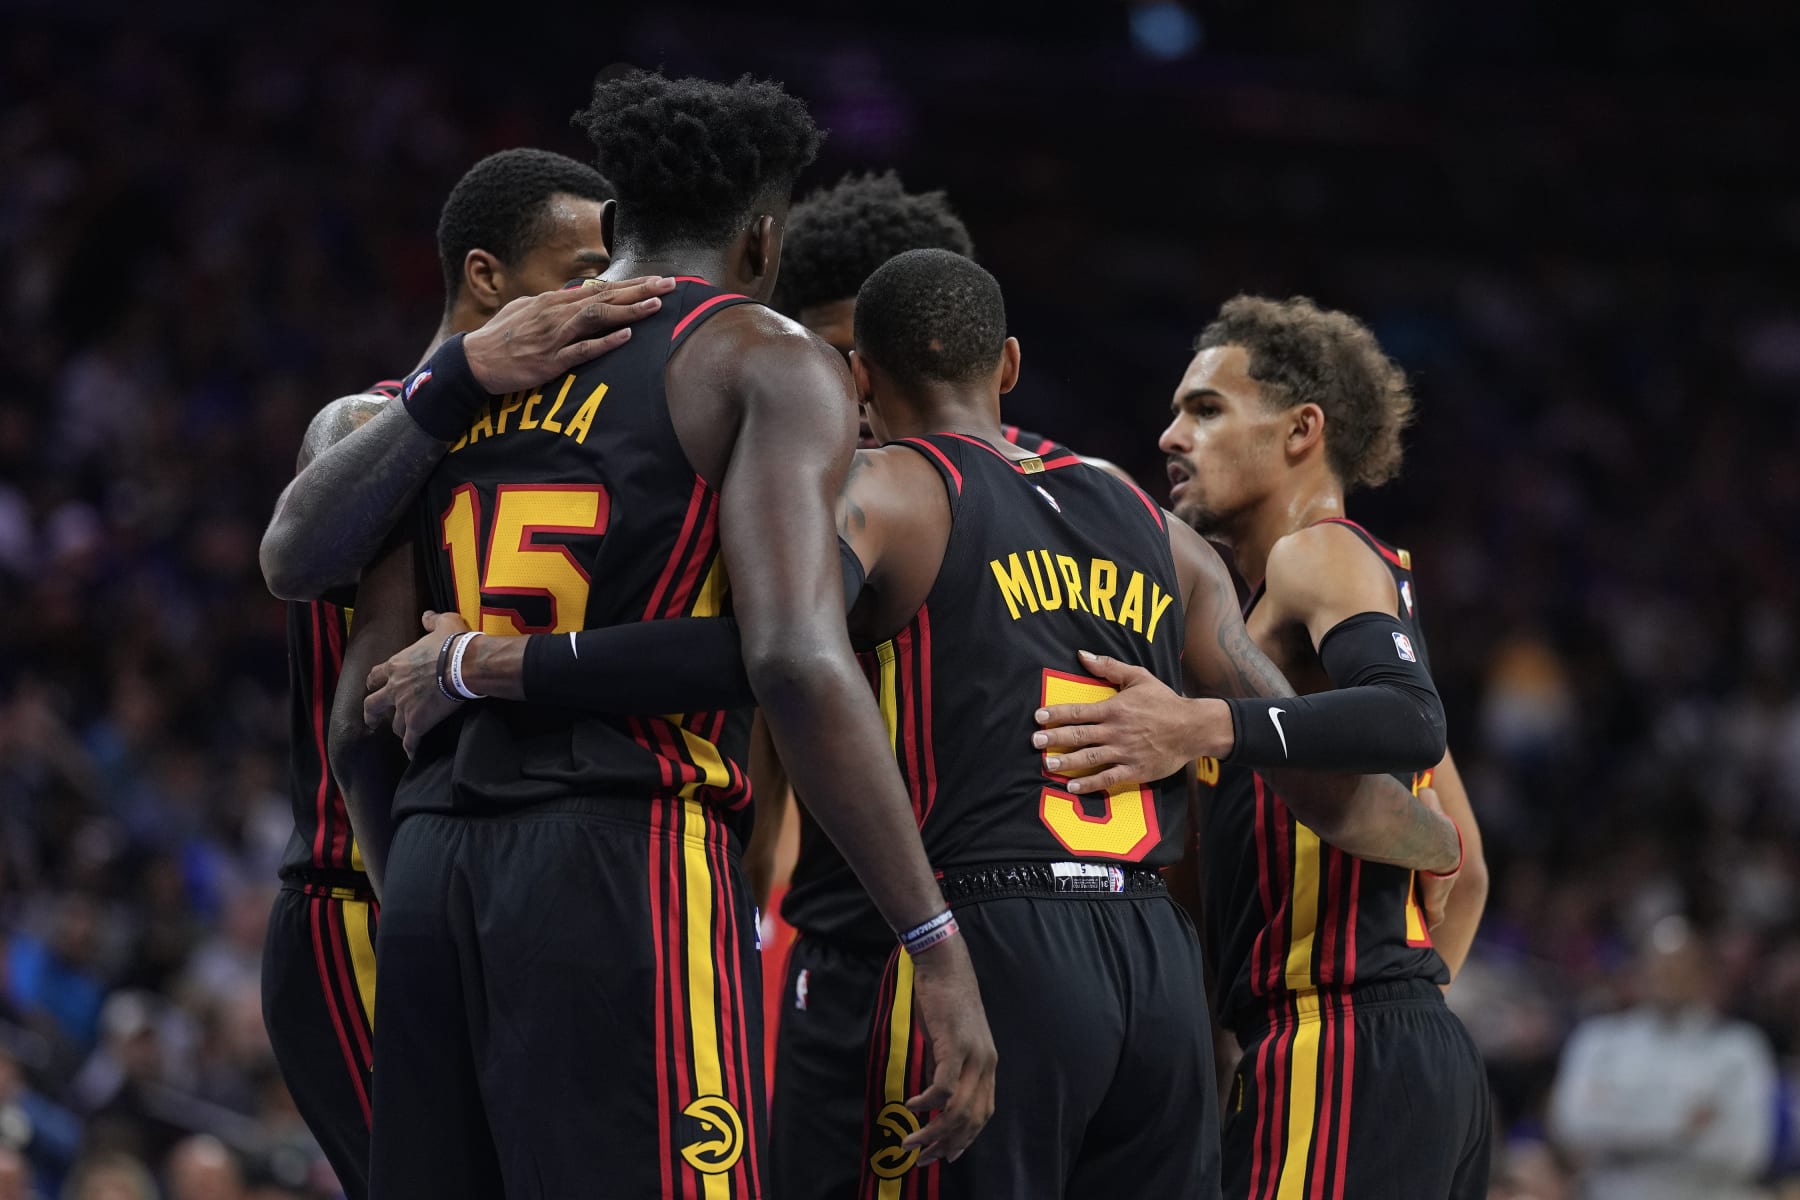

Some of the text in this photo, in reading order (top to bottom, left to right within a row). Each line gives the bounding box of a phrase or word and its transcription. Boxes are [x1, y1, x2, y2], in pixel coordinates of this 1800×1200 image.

[450, 373, 609, 454] APELA
[440, 481, 611, 635] 15
[990, 549, 1173, 644] MURRAY
